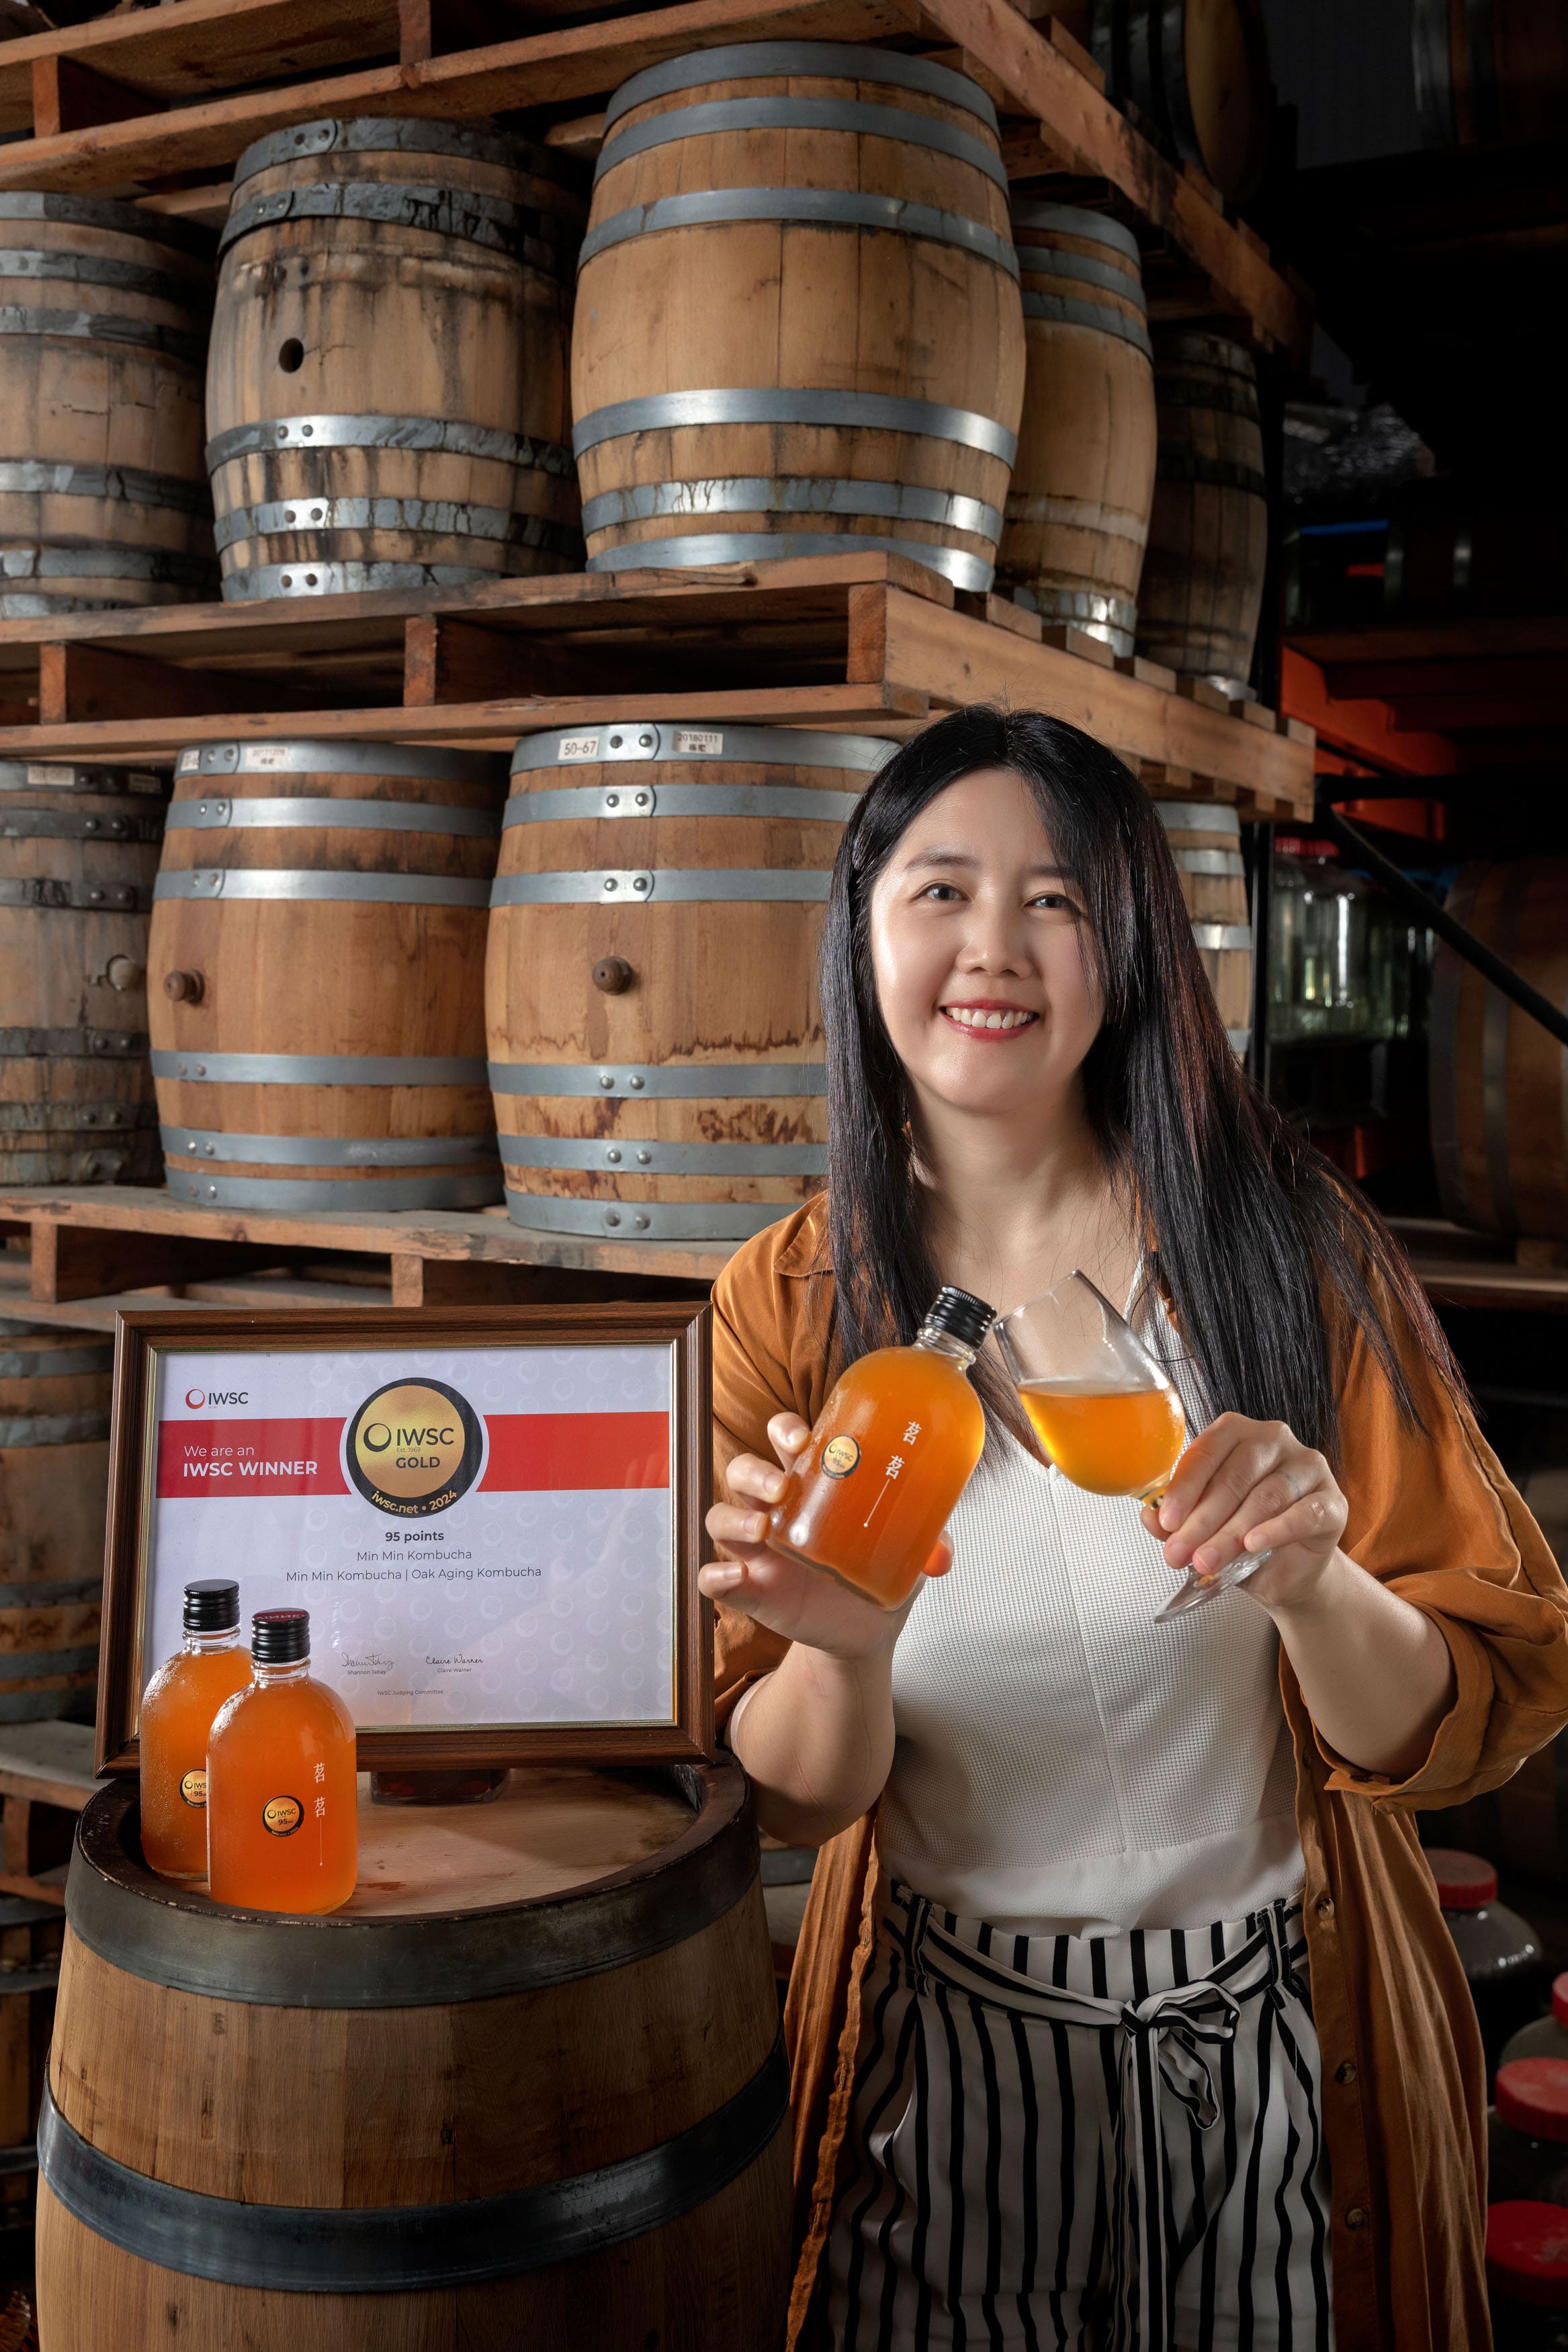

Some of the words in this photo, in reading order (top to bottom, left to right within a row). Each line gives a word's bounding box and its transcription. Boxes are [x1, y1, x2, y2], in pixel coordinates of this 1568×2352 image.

[564, 741, 597, 755] 50-67
[208, 1392, 249, 1405] IWSC
[396, 1427, 455, 1446] IWSC
[184, 1445, 207, 1457] We
[211, 1447, 233, 1457] are
[237, 1447, 255, 1456] an
[183, 1462, 233, 1477] IWSC
[238, 1461, 318, 1476] WINNER
[396, 1456, 441, 1469] GOLD
[372, 1490, 419, 1513] iwsc.net
[429, 1490, 458, 1511] 2024
[385, 1531, 400, 1542] 95
[404, 1530, 445, 1544] points
[357, 1551, 378, 1562] Min
[382, 1550, 404, 1561] Min
[408, 1549, 472, 1560] Kombucha
[287, 1571, 308, 1581] Min
[312, 1570, 333, 1581] Min
[337, 1569, 402, 1581] Kombucha
[411, 1569, 435, 1579] Oak
[438, 1568, 473, 1580] Aging
[478, 1566, 541, 1577] Kombucha
[277, 1808, 296, 1817] IWSC
